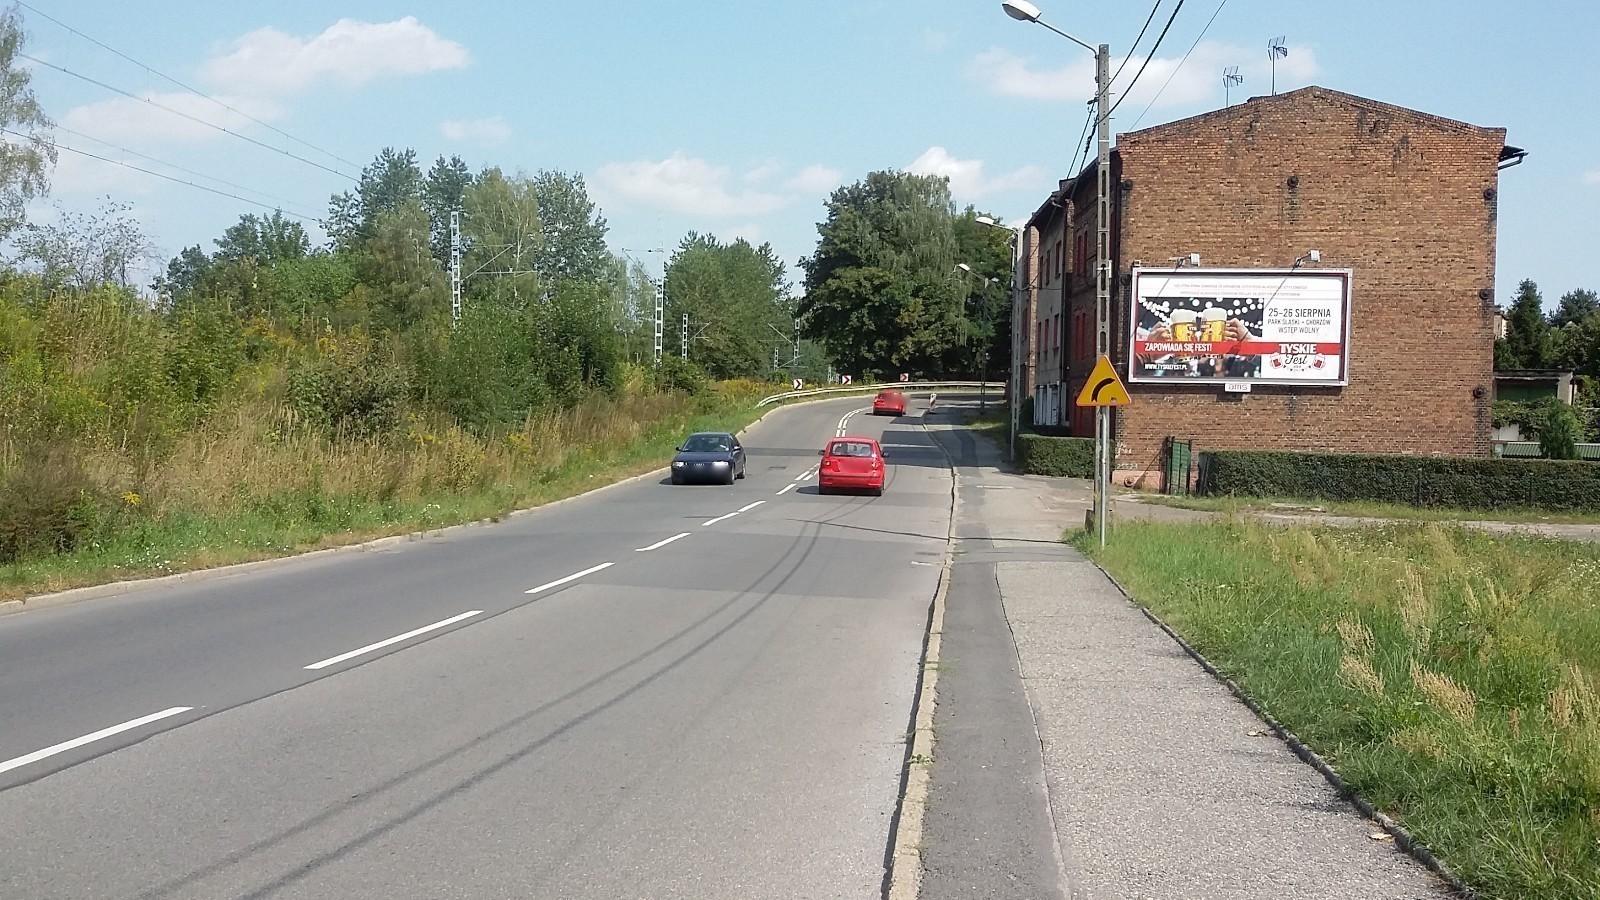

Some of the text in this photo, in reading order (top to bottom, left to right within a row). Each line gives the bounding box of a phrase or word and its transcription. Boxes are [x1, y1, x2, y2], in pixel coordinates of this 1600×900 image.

[1295, 308, 1331, 318] SIERPNIA
[1299, 326, 1320, 334] WOLNY
[1144, 342, 1183, 352] ZAPOWIADA
[1194, 343, 1212, 352] FEST!
[1279, 343, 1317, 354] TYSKIE
